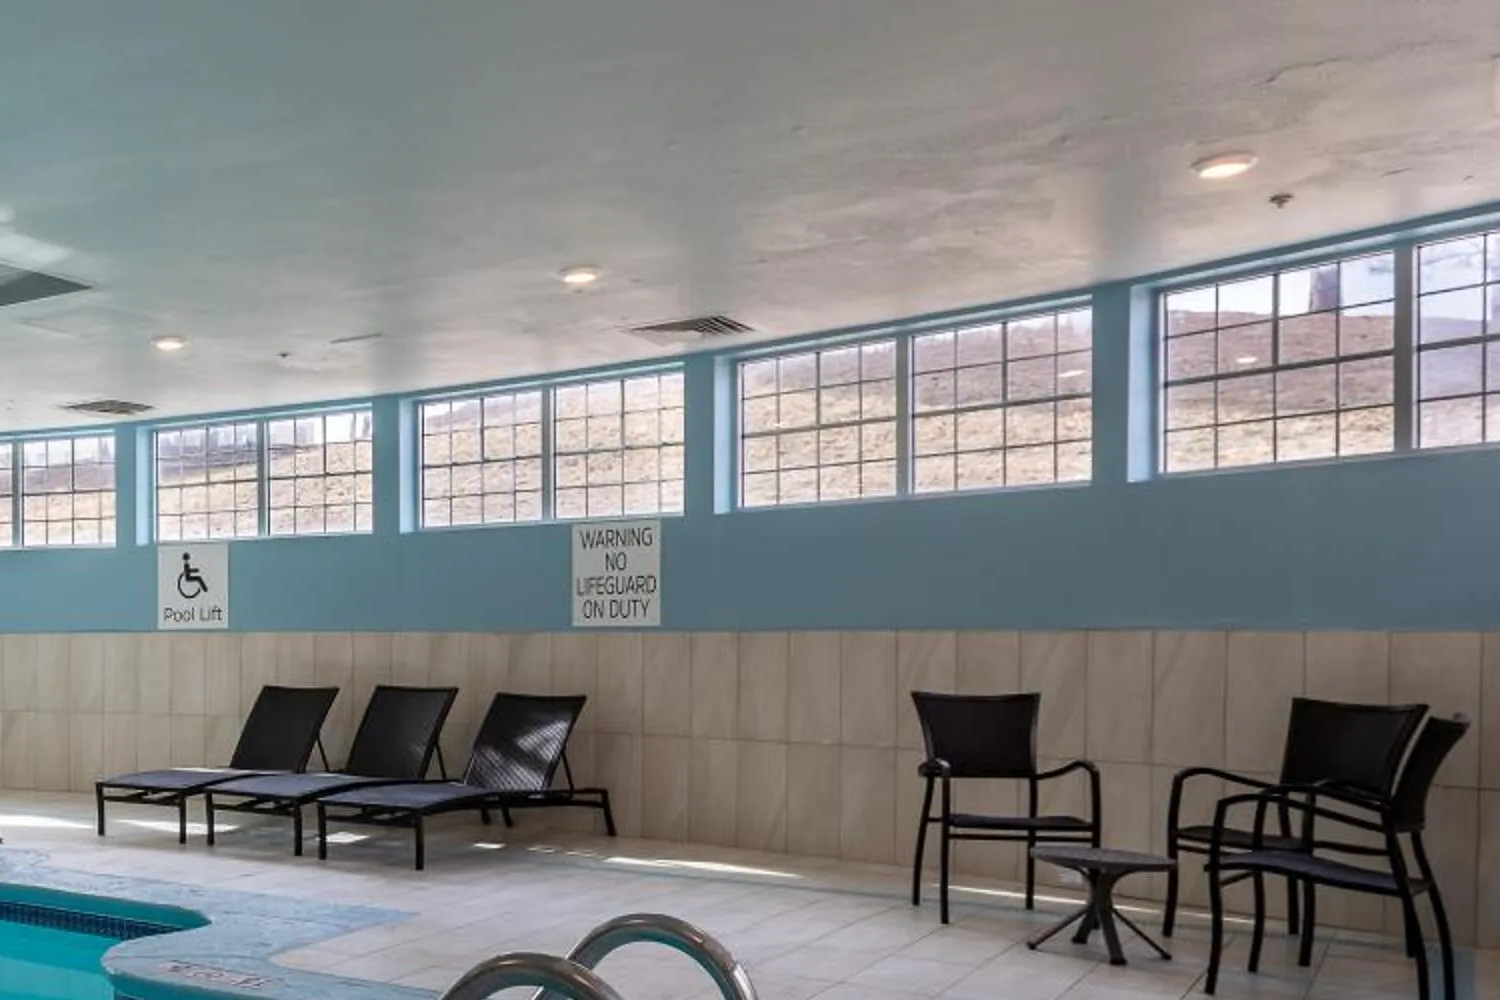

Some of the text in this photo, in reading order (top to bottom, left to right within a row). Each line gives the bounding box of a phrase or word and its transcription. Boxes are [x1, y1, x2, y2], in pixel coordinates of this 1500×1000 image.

[579, 527, 653, 549] WARNING
[605, 552, 627, 571] NO
[577, 575, 657, 596] LIFEGUARD
[163, 605, 223, 622] Pool Lift
[583, 599, 651, 619] ON DUTY
